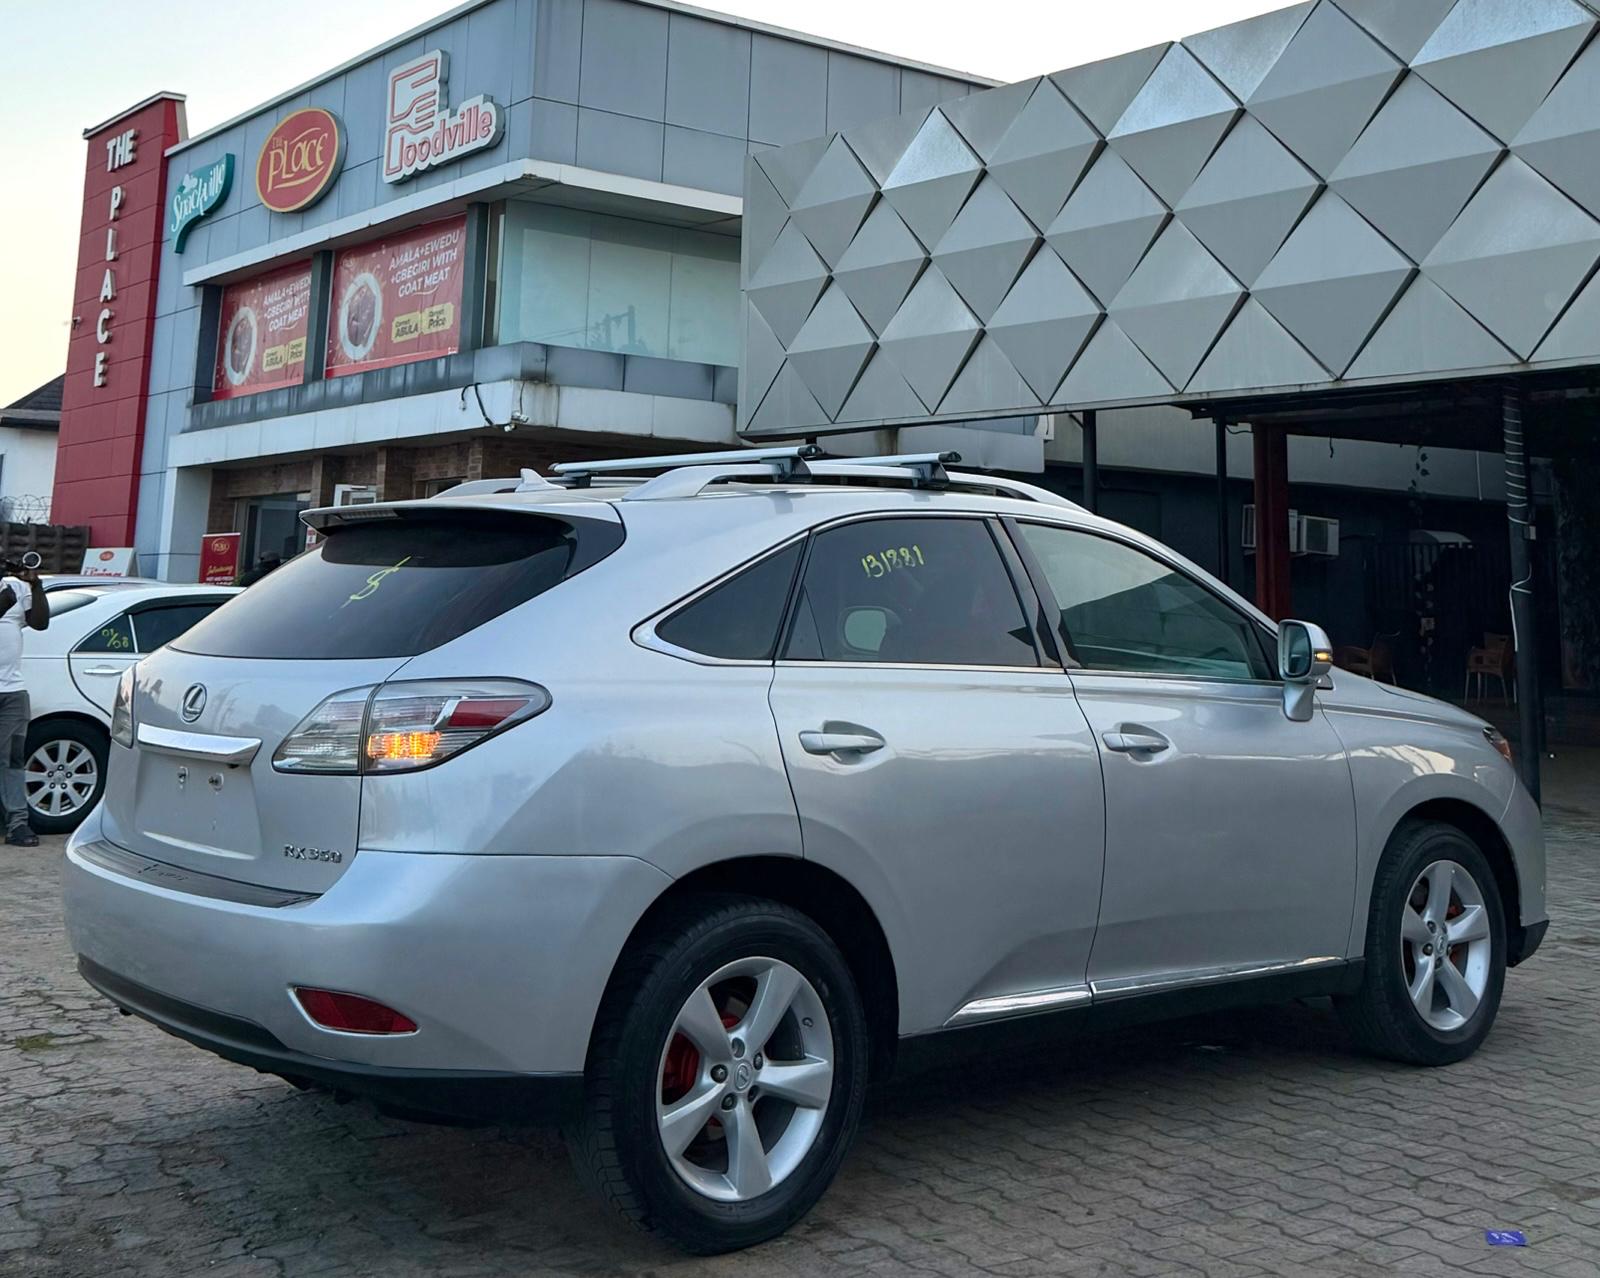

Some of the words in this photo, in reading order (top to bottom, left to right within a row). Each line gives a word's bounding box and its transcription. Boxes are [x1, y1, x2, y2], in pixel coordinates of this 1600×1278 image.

[385, 58, 493, 176] Foodville
[106, 128, 135, 172] THE
[432, 247, 457, 270] WITH
[93, 185, 123, 388] PLACE
[399, 277, 424, 298] GOAT
[424, 266, 450, 289] MEAT
